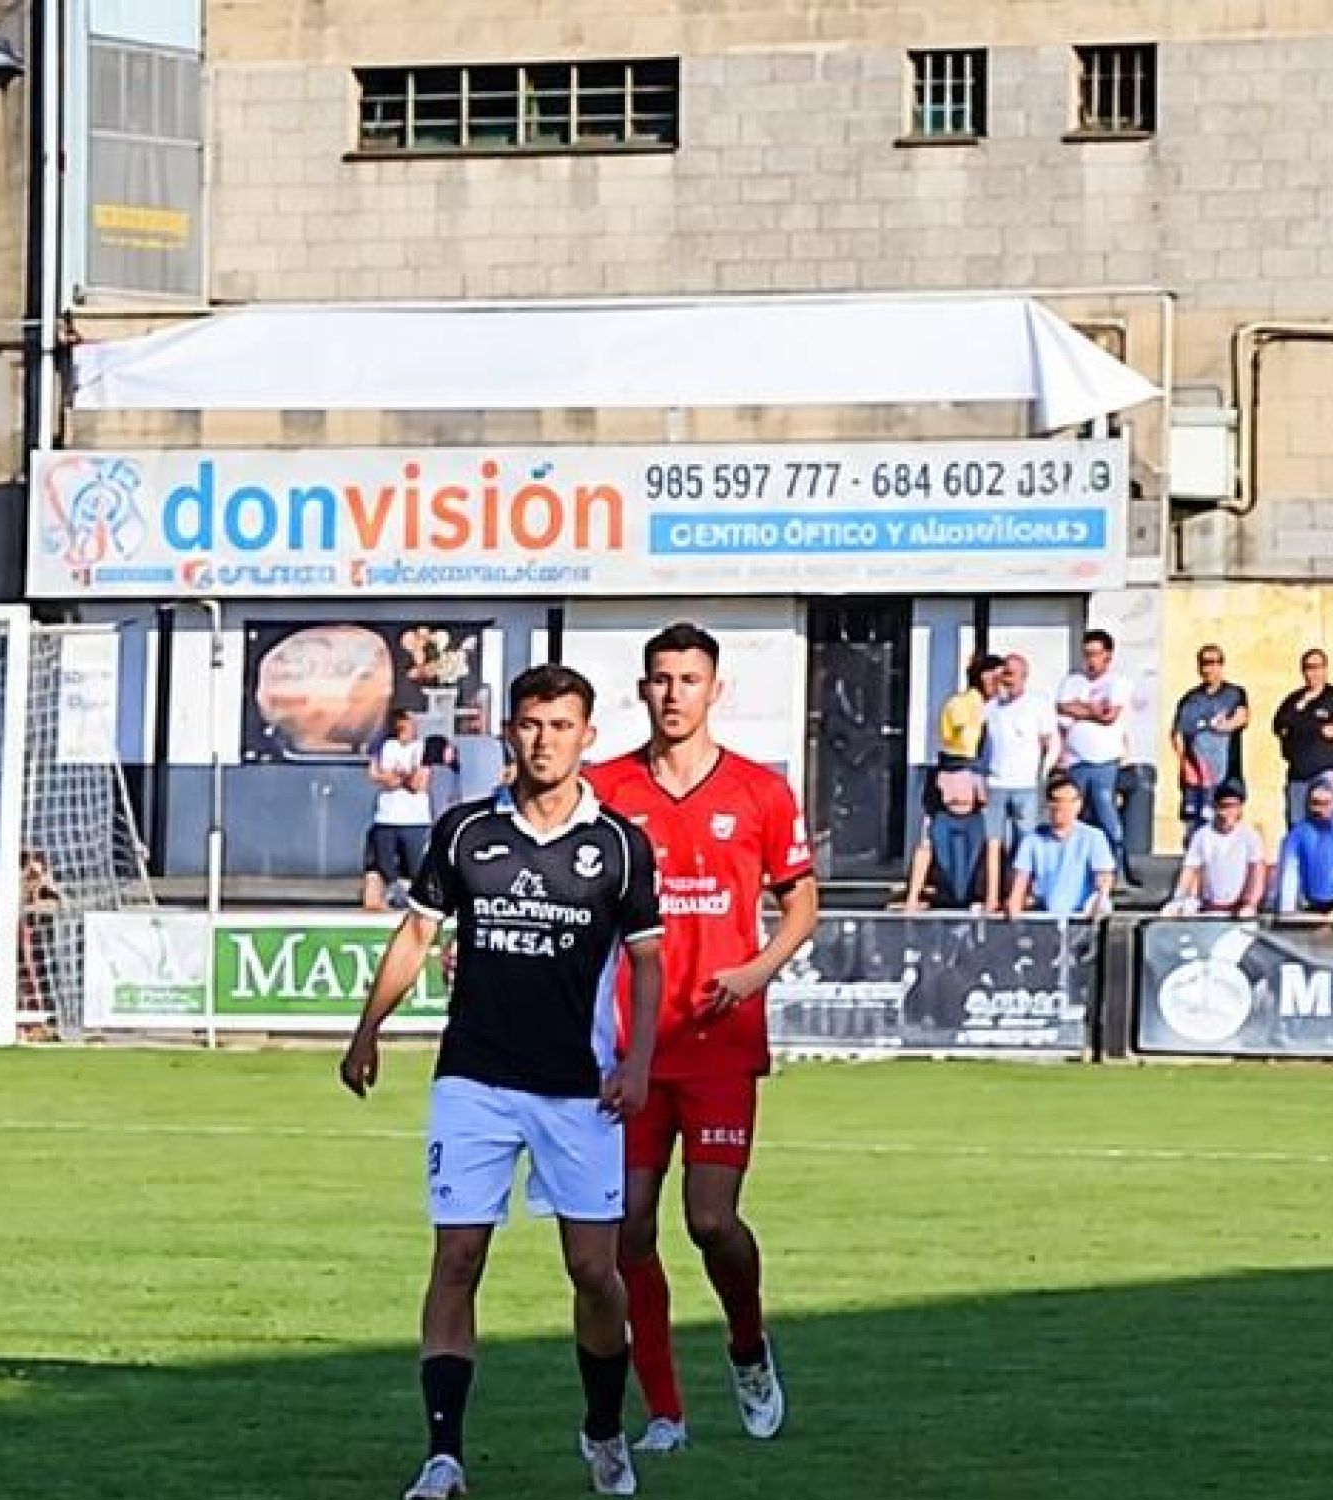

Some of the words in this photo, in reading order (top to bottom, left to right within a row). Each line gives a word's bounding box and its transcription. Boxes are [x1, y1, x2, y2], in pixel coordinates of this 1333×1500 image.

[163, 460, 624, 553] donvisión
[646, 463, 703, 499] 985
[713, 463, 771, 499] 597
[784, 462, 842, 499] 777
[872, 461, 932, 498] 684
[943, 460, 1005, 498] 602
